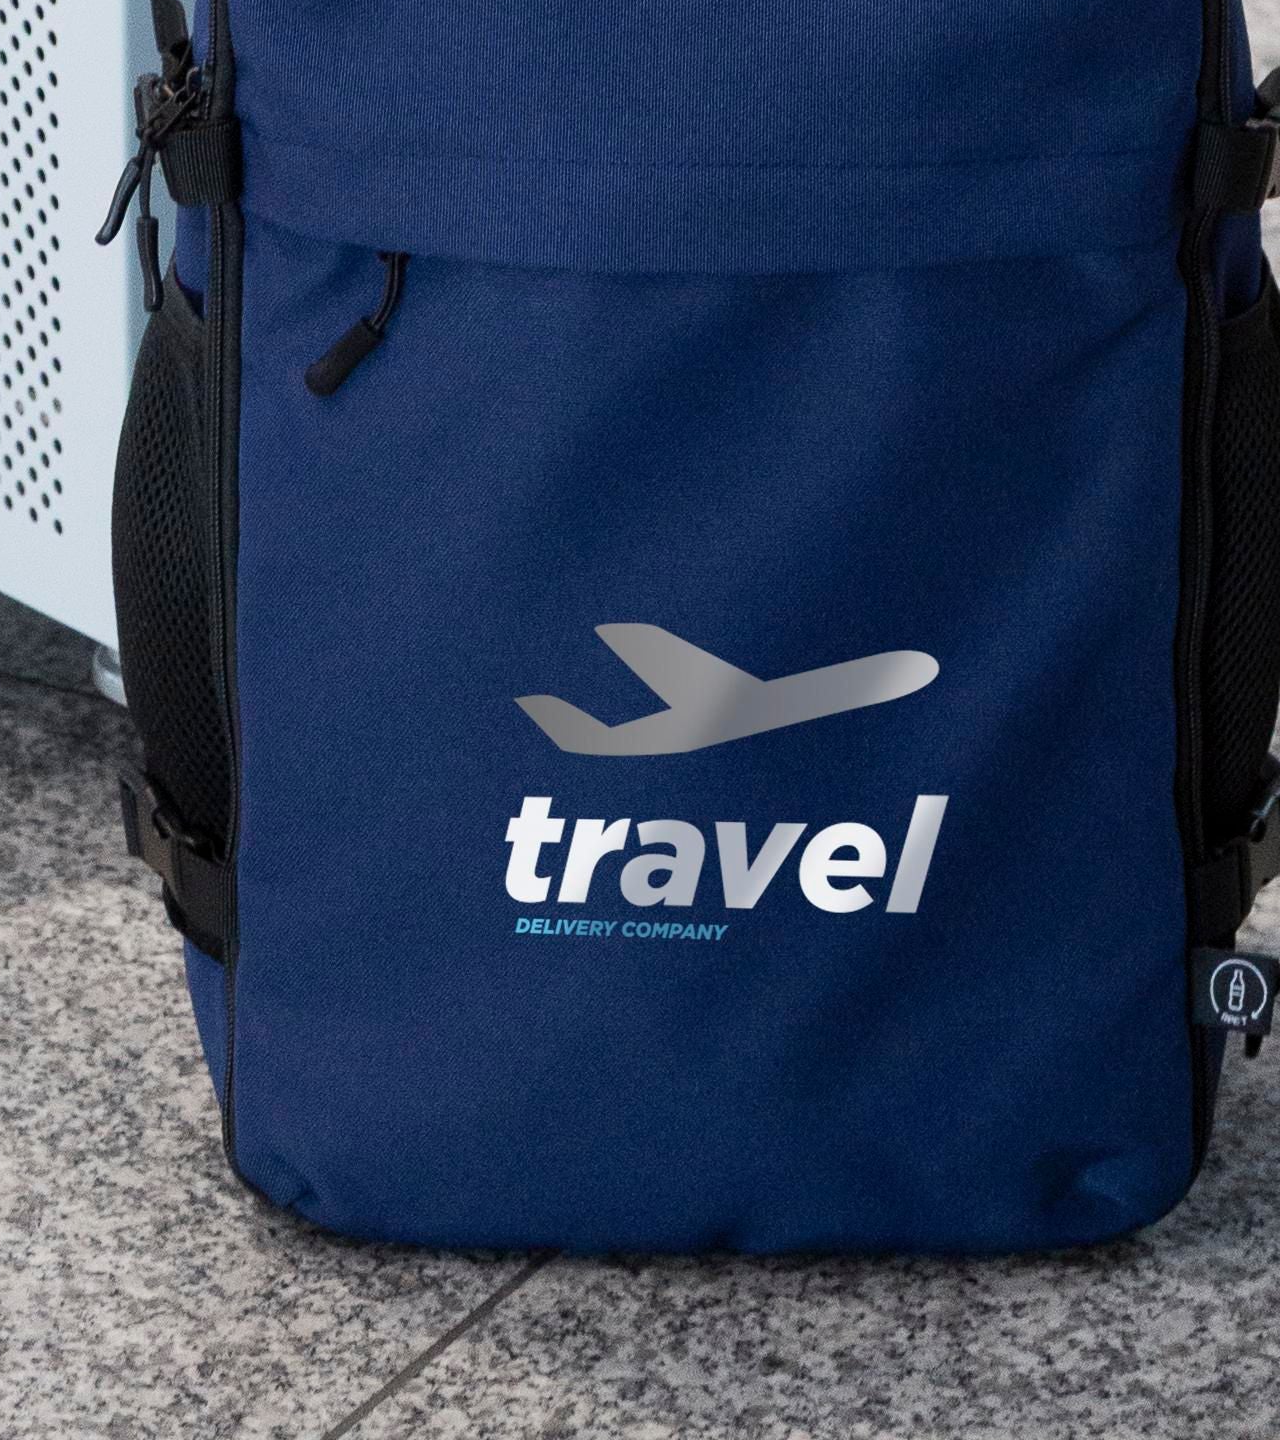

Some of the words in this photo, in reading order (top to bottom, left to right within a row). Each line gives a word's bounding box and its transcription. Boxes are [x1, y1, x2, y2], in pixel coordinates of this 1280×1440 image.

[504, 793, 949, 915] travel
[515, 917, 617, 937] DELIVERY
[621, 921, 729, 941] COMPANY
